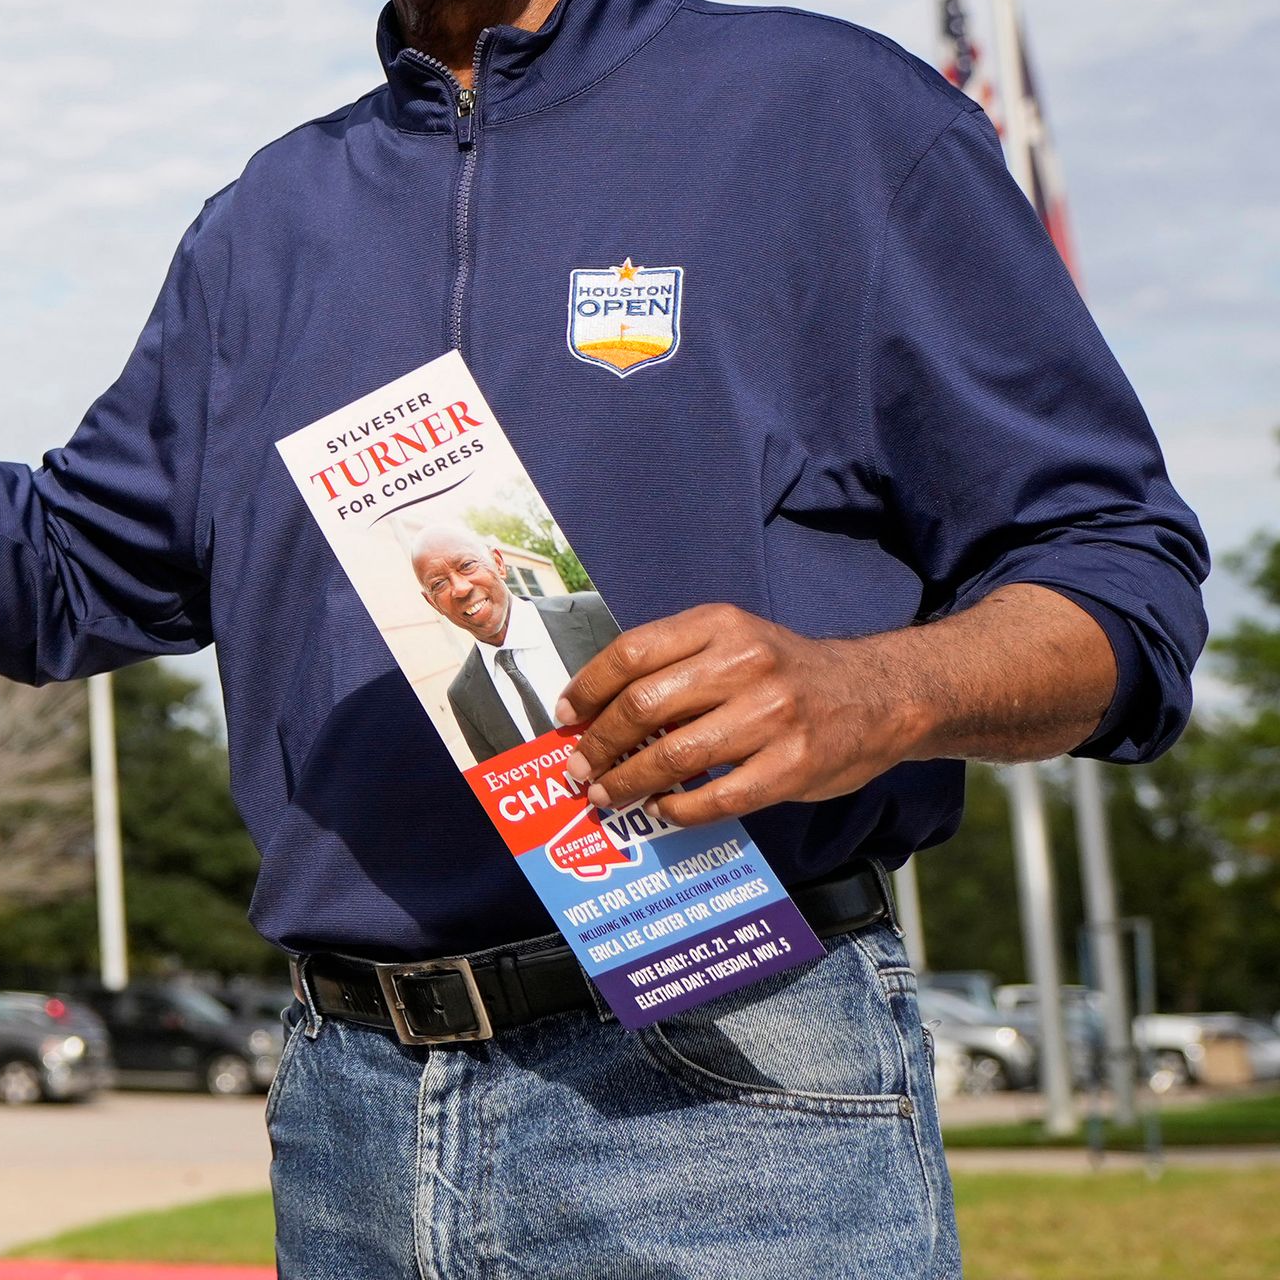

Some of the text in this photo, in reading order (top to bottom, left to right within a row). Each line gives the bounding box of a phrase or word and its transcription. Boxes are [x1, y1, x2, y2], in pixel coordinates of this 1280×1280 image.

[577, 297, 672, 317] OPEN
[579, 284, 673, 297] HOUSTON
[309, 400, 485, 503] TURNER
[326, 392, 432, 454] SYLVESTER
[337, 438, 485, 521] FOR CONGRESS
[555, 830, 602, 858] ELECTION
[581, 840, 609, 858] 2024
[563, 838, 745, 928] VOTE FOR EVERY DEMOCRAT
[578, 919, 621, 944] INCLUDING
[618, 915, 631, 927] IN
[629, 908, 647, 922] THE
[644, 895, 678, 916] SPECIAL
[676, 879, 715, 903] ELECTION
[713, 874, 731, 888] FOR
[729, 868, 742, 881] CD
[587, 877, 770, 964] ERICA LEE CARTER FOR CONGRESS
[627, 965, 658, 988] VOTE
[653, 953, 693, 978] EARLY:
[689, 943, 716, 963] OCT.
[711, 936, 729, 955] 21
[733, 923, 765, 946] NOV.
[759, 919, 772, 934] 1
[634, 936, 792, 1011] ELECTION DAY: TUESDAY, NOV. 5
